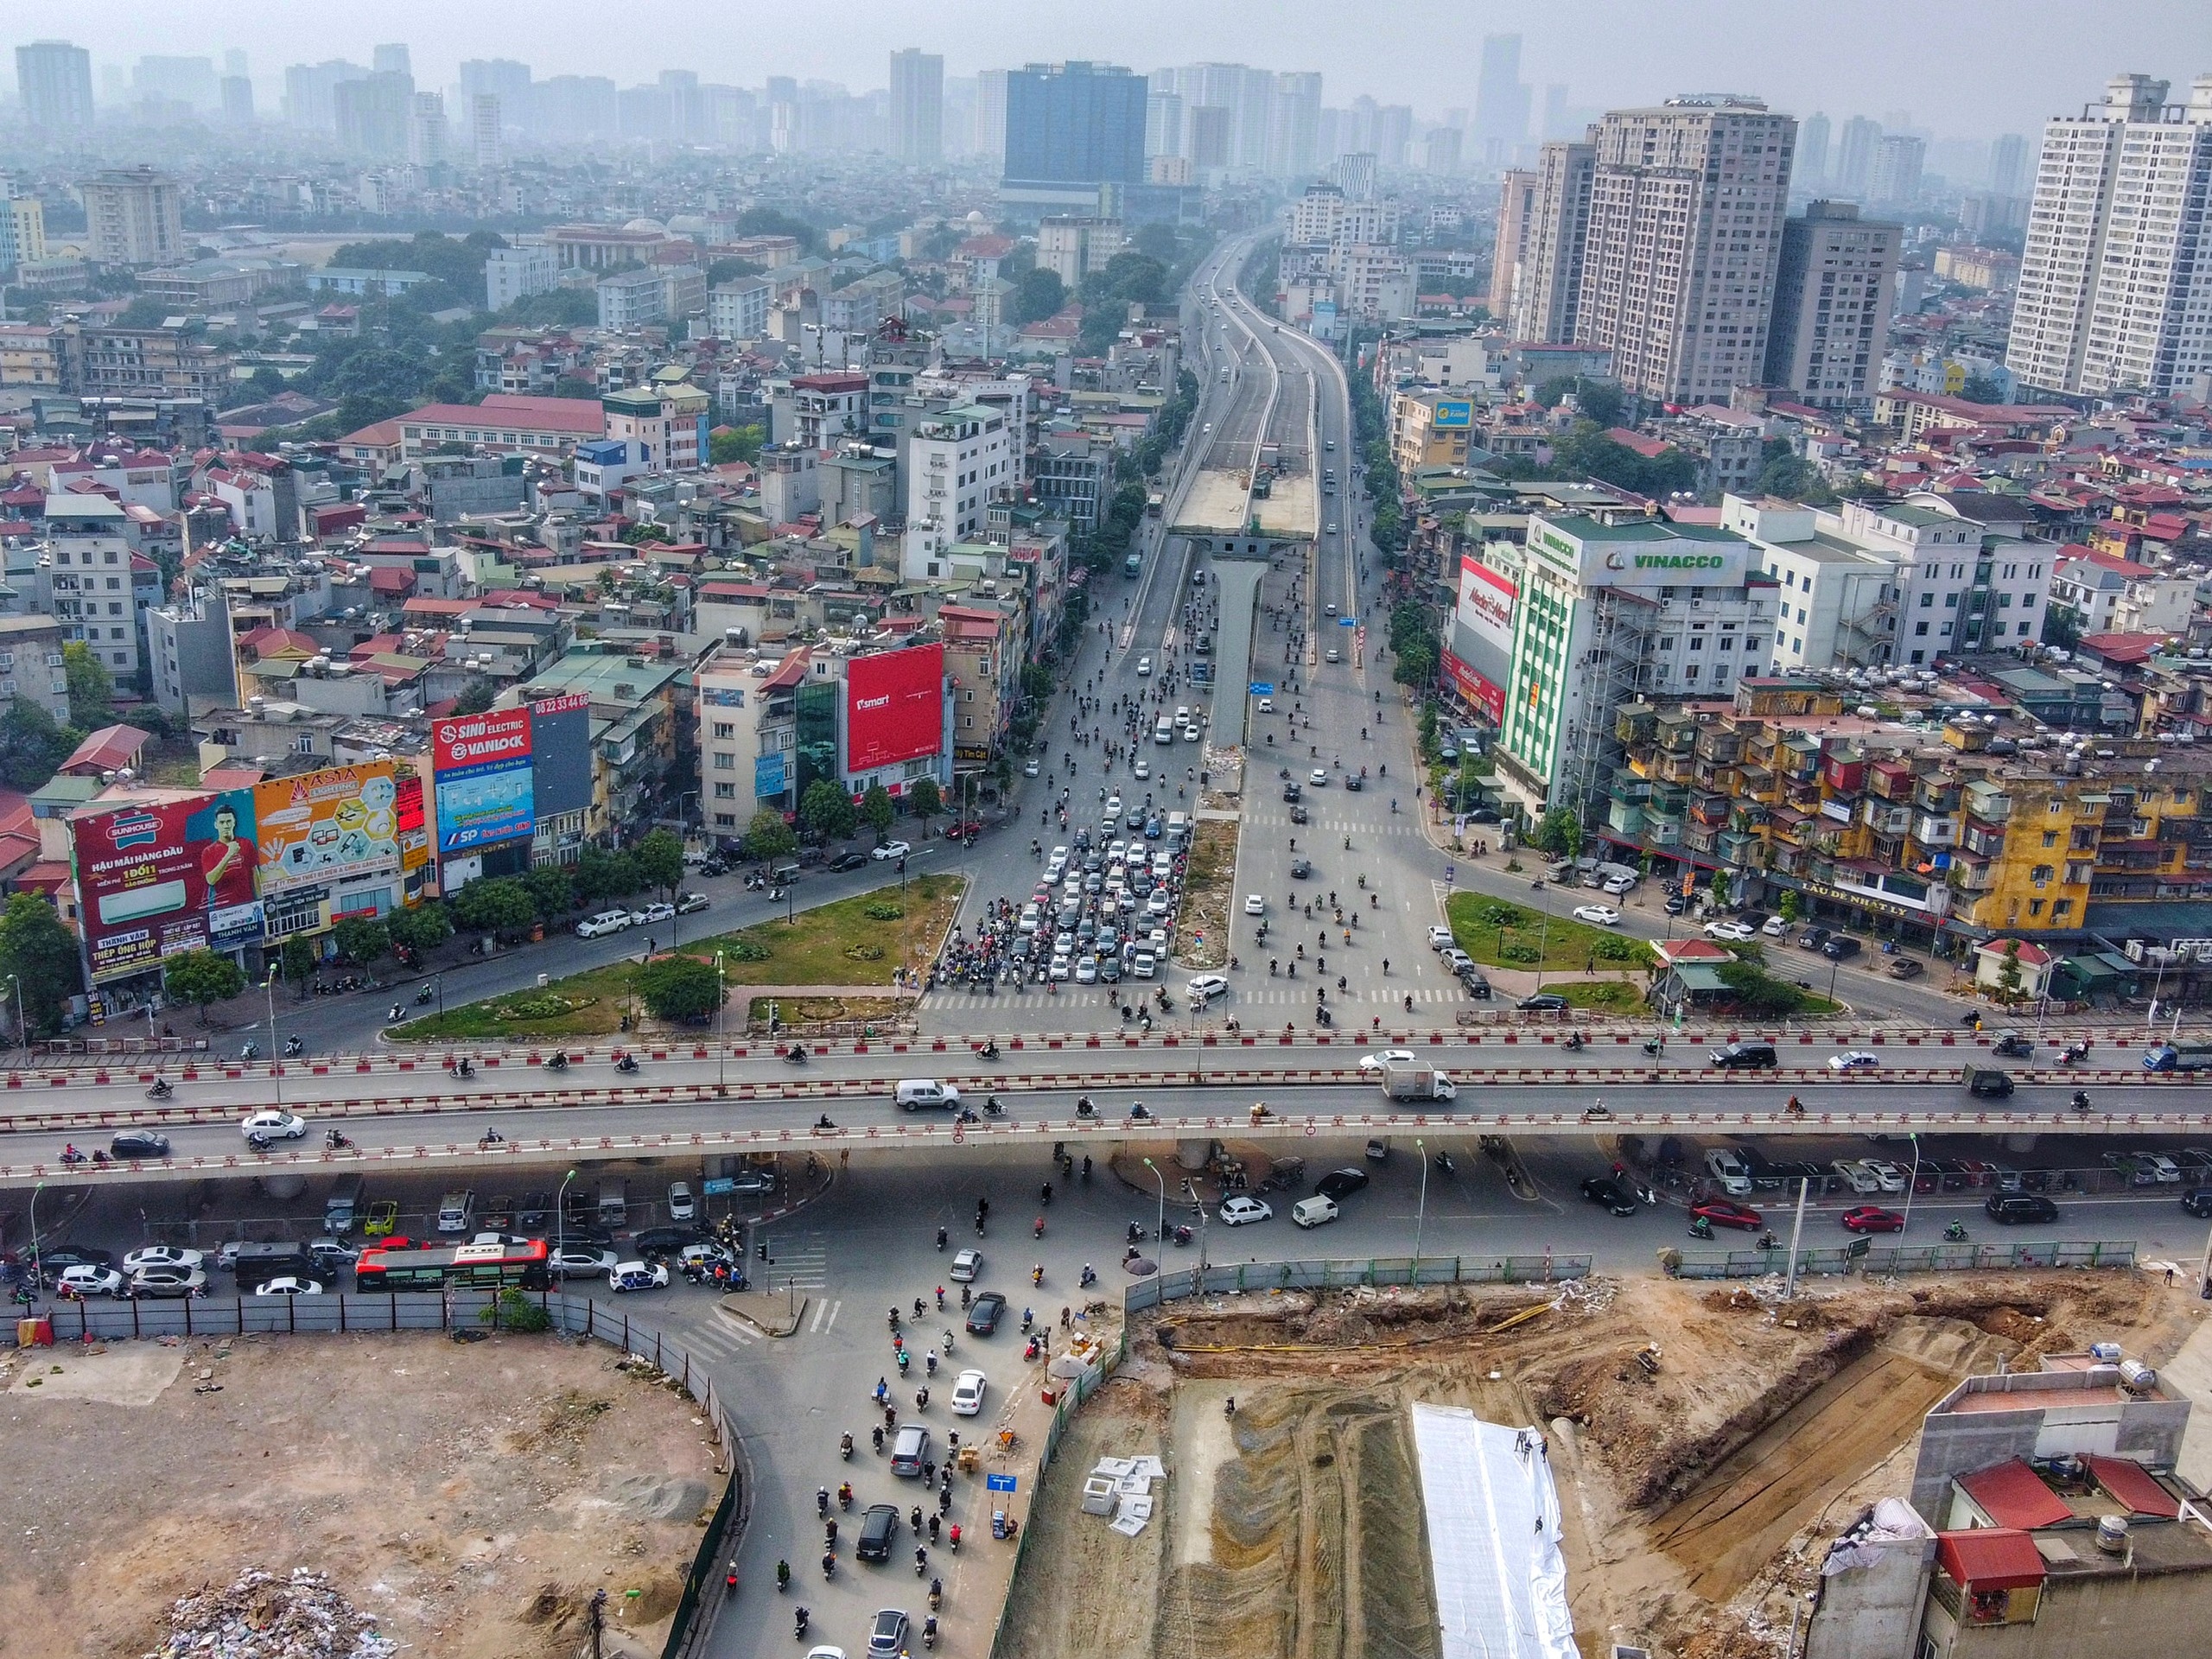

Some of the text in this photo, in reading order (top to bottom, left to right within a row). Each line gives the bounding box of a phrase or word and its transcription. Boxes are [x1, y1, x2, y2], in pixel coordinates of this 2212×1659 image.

[1543, 531, 1574, 558] VINACCO
[1635, 555, 1724, 569] VINACCO
[536, 696, 588, 714] 08 22 33 44 66
[458, 720, 524, 739] SINO ELECTRIC
[467, 735, 524, 755] VANLOCK
[309, 767, 358, 787] ASIA
[311, 782, 358, 796] LIGHTING
[111, 822, 157, 836] SUNHOUSE
[461, 830, 478, 842] SP
[92, 846, 183, 873] HẬU MÃI HÀNG ĐẦU
[1890, 906, 1908, 916] LY
[101, 935, 128, 947] THANH
[218, 928, 242, 939] THANH
[92, 948, 115, 961] THÉP
[118, 943, 137, 956] ỐNG
[139, 939, 156, 951] HỘP
